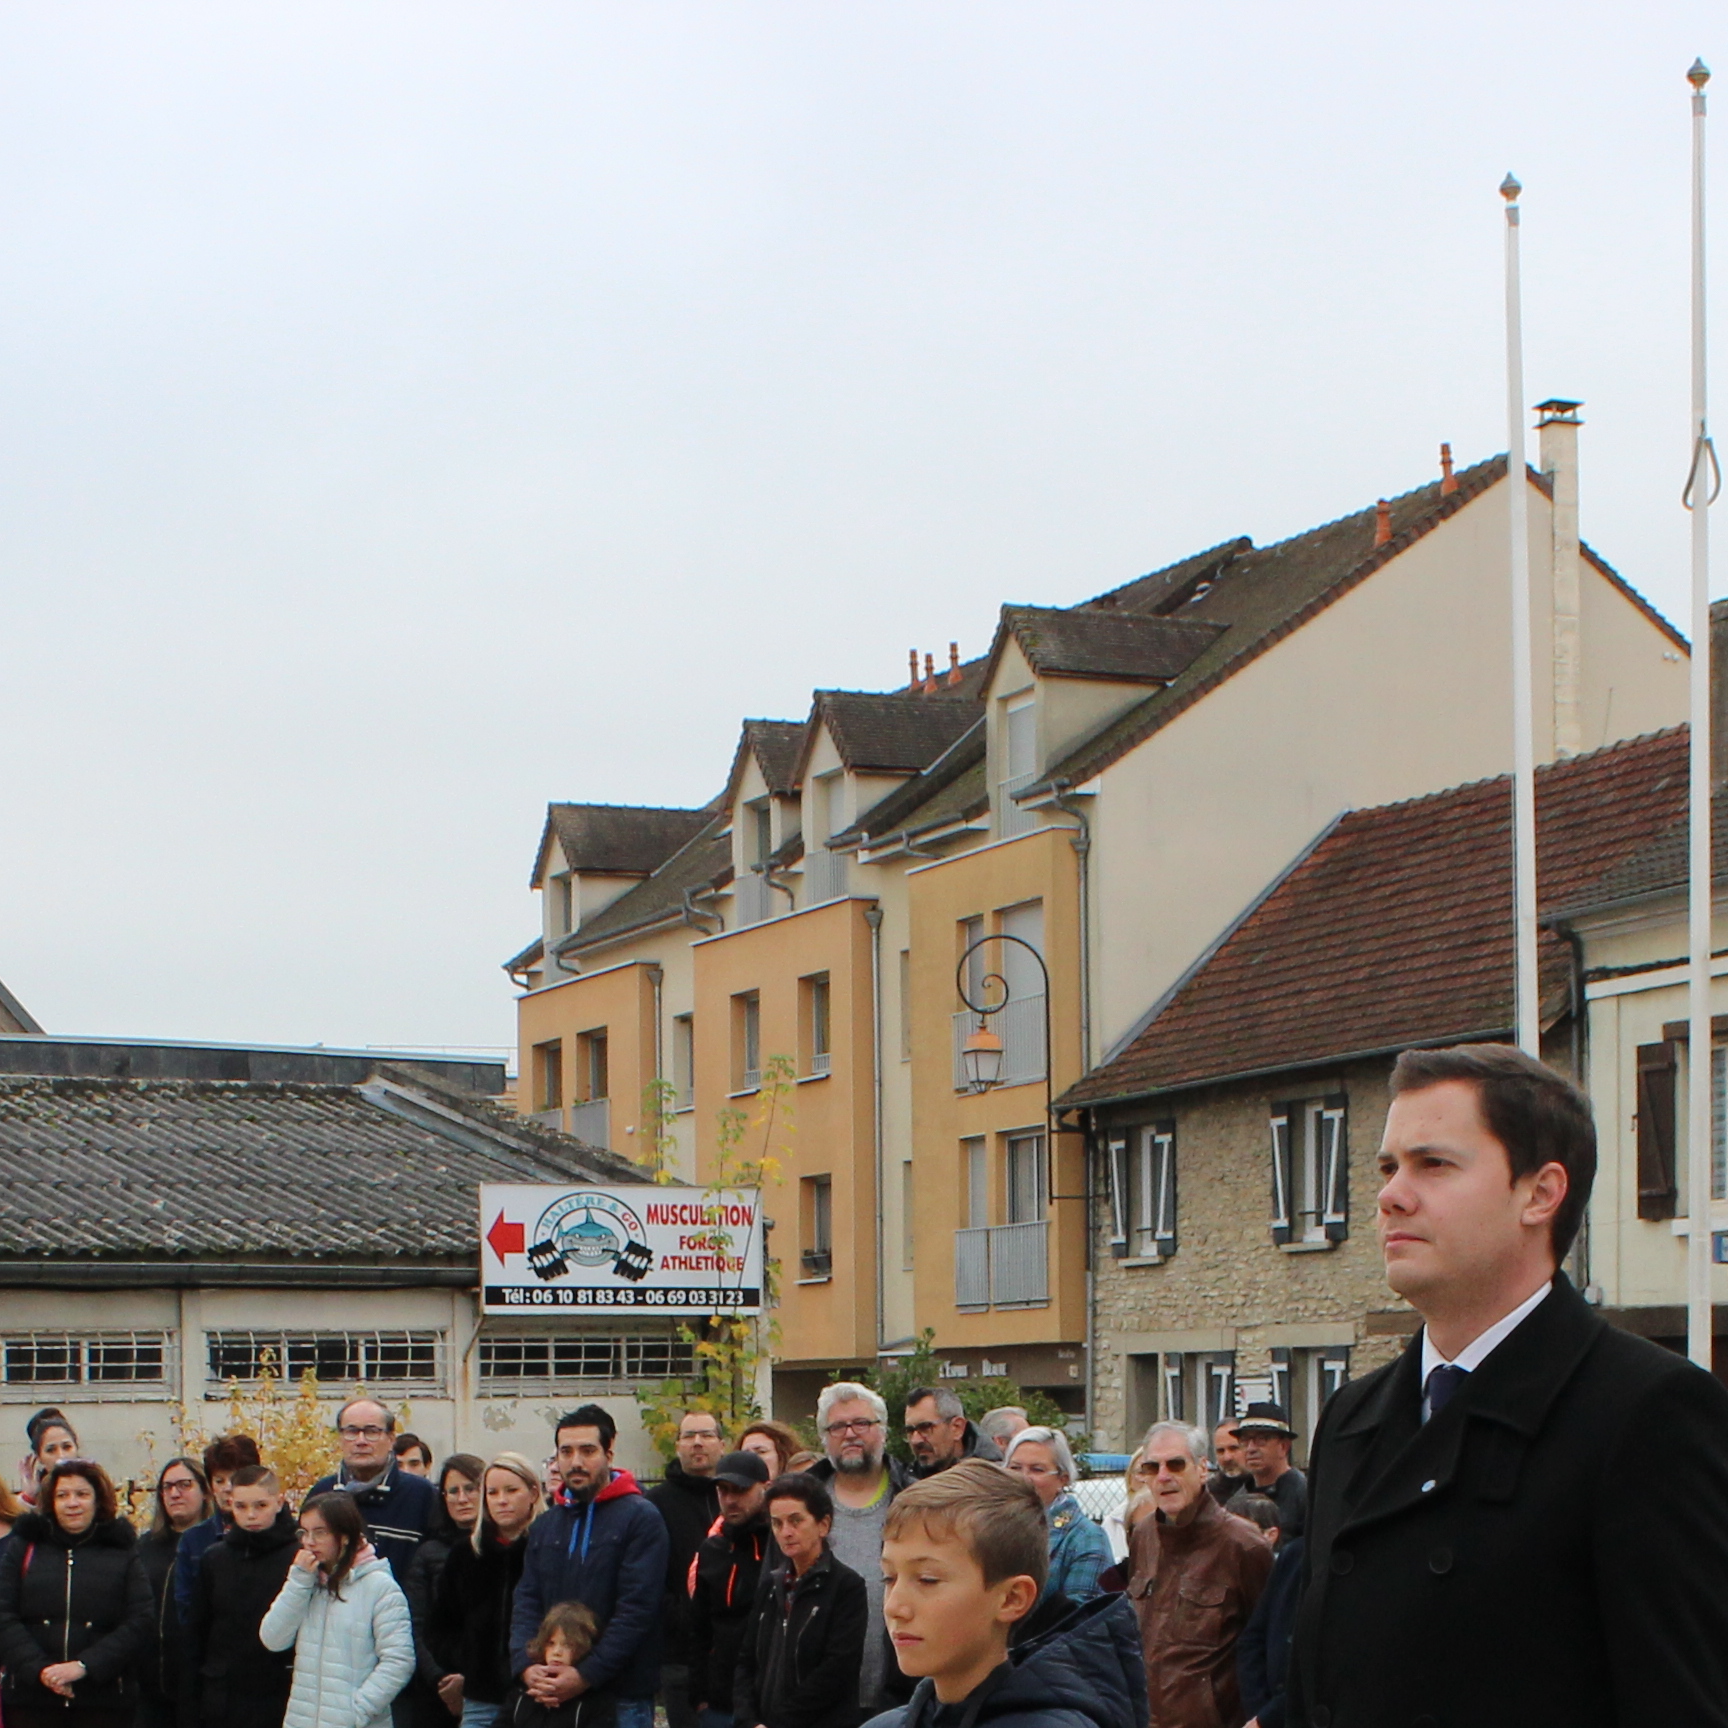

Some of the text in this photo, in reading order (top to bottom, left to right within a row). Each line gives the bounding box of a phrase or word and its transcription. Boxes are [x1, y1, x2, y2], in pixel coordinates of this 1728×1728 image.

[621, 1212, 639, 1231] GO
[660, 1255, 745, 1273] ATHLETIQUE
[532, 1289, 553, 1304] 06
[556, 1289, 574, 1304] 10
[576, 1289, 593, 1304] 81
[595, 1289, 615, 1304] 83
[616, 1289, 635, 1304] 43
[645, 1290, 665, 1305] 06
[667, 1290, 686, 1305] 69
[688, 1290, 707, 1305] 03
[708, 1290, 724, 1305] 31
[726, 1290, 744, 1305] 23
